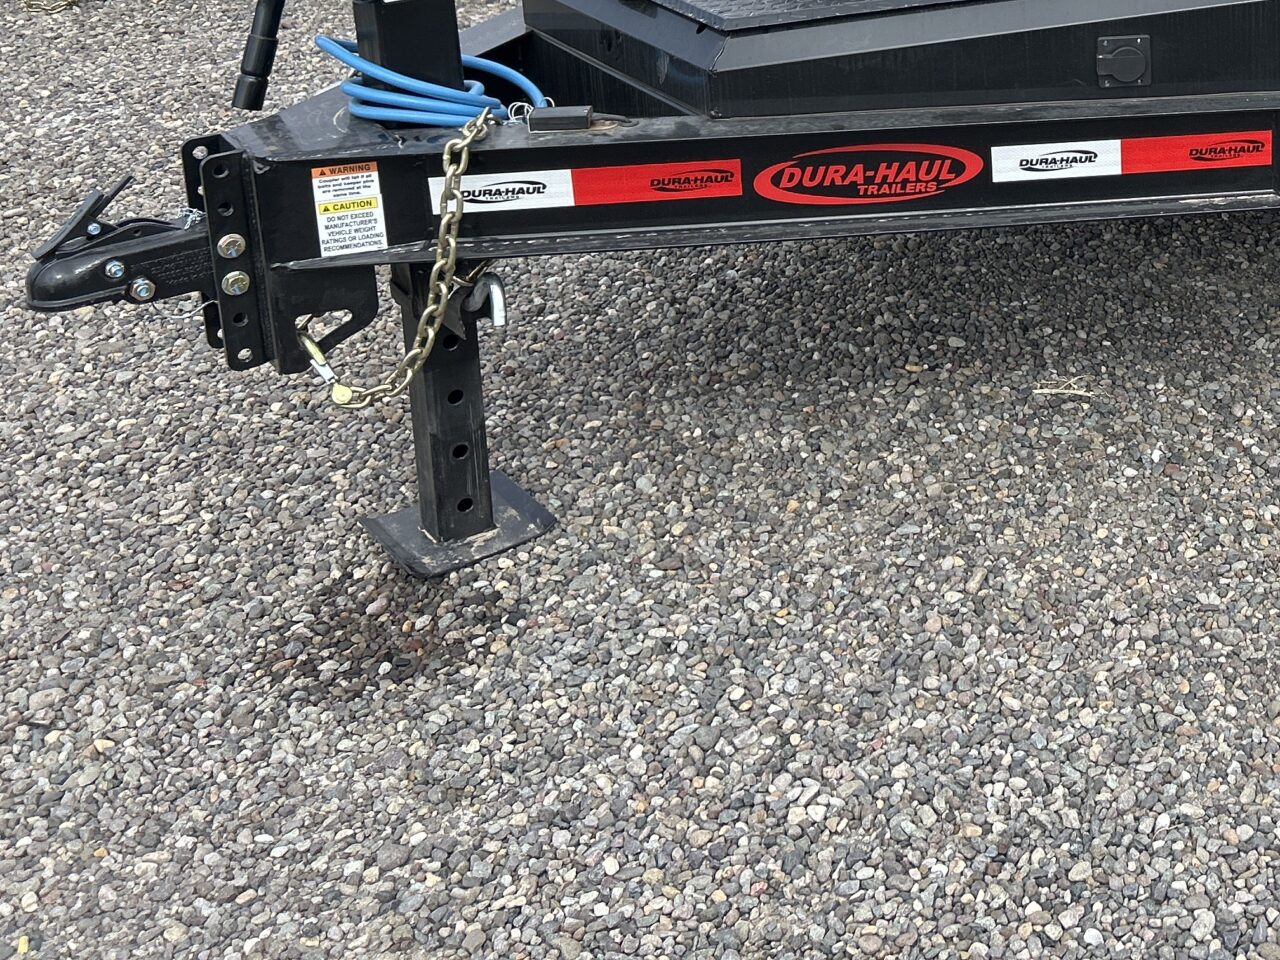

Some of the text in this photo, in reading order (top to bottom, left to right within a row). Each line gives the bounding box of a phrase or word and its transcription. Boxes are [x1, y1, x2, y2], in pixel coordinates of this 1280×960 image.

[1188, 143, 1265, 157] DURA-HAUL
[1019, 155, 1097, 168] DURA-HAUL
[328, 163, 371, 175] WARNING
[779, 159, 956, 189] DURA-HAUL
[650, 174, 733, 187] DURA-HAUL
[460, 186, 545, 198] DURA-HAUL
[857, 181, 938, 195] TRAILERS
[332, 200, 372, 211] CAUTION
[350, 212, 374, 220] EXCEED
[324, 218, 378, 230] MANUFACTURER'S
[327, 226, 376, 237] VEHICLE WEIGHT
[322, 237, 346, 245] RATINGS
[358, 232, 384, 240] LOADING
